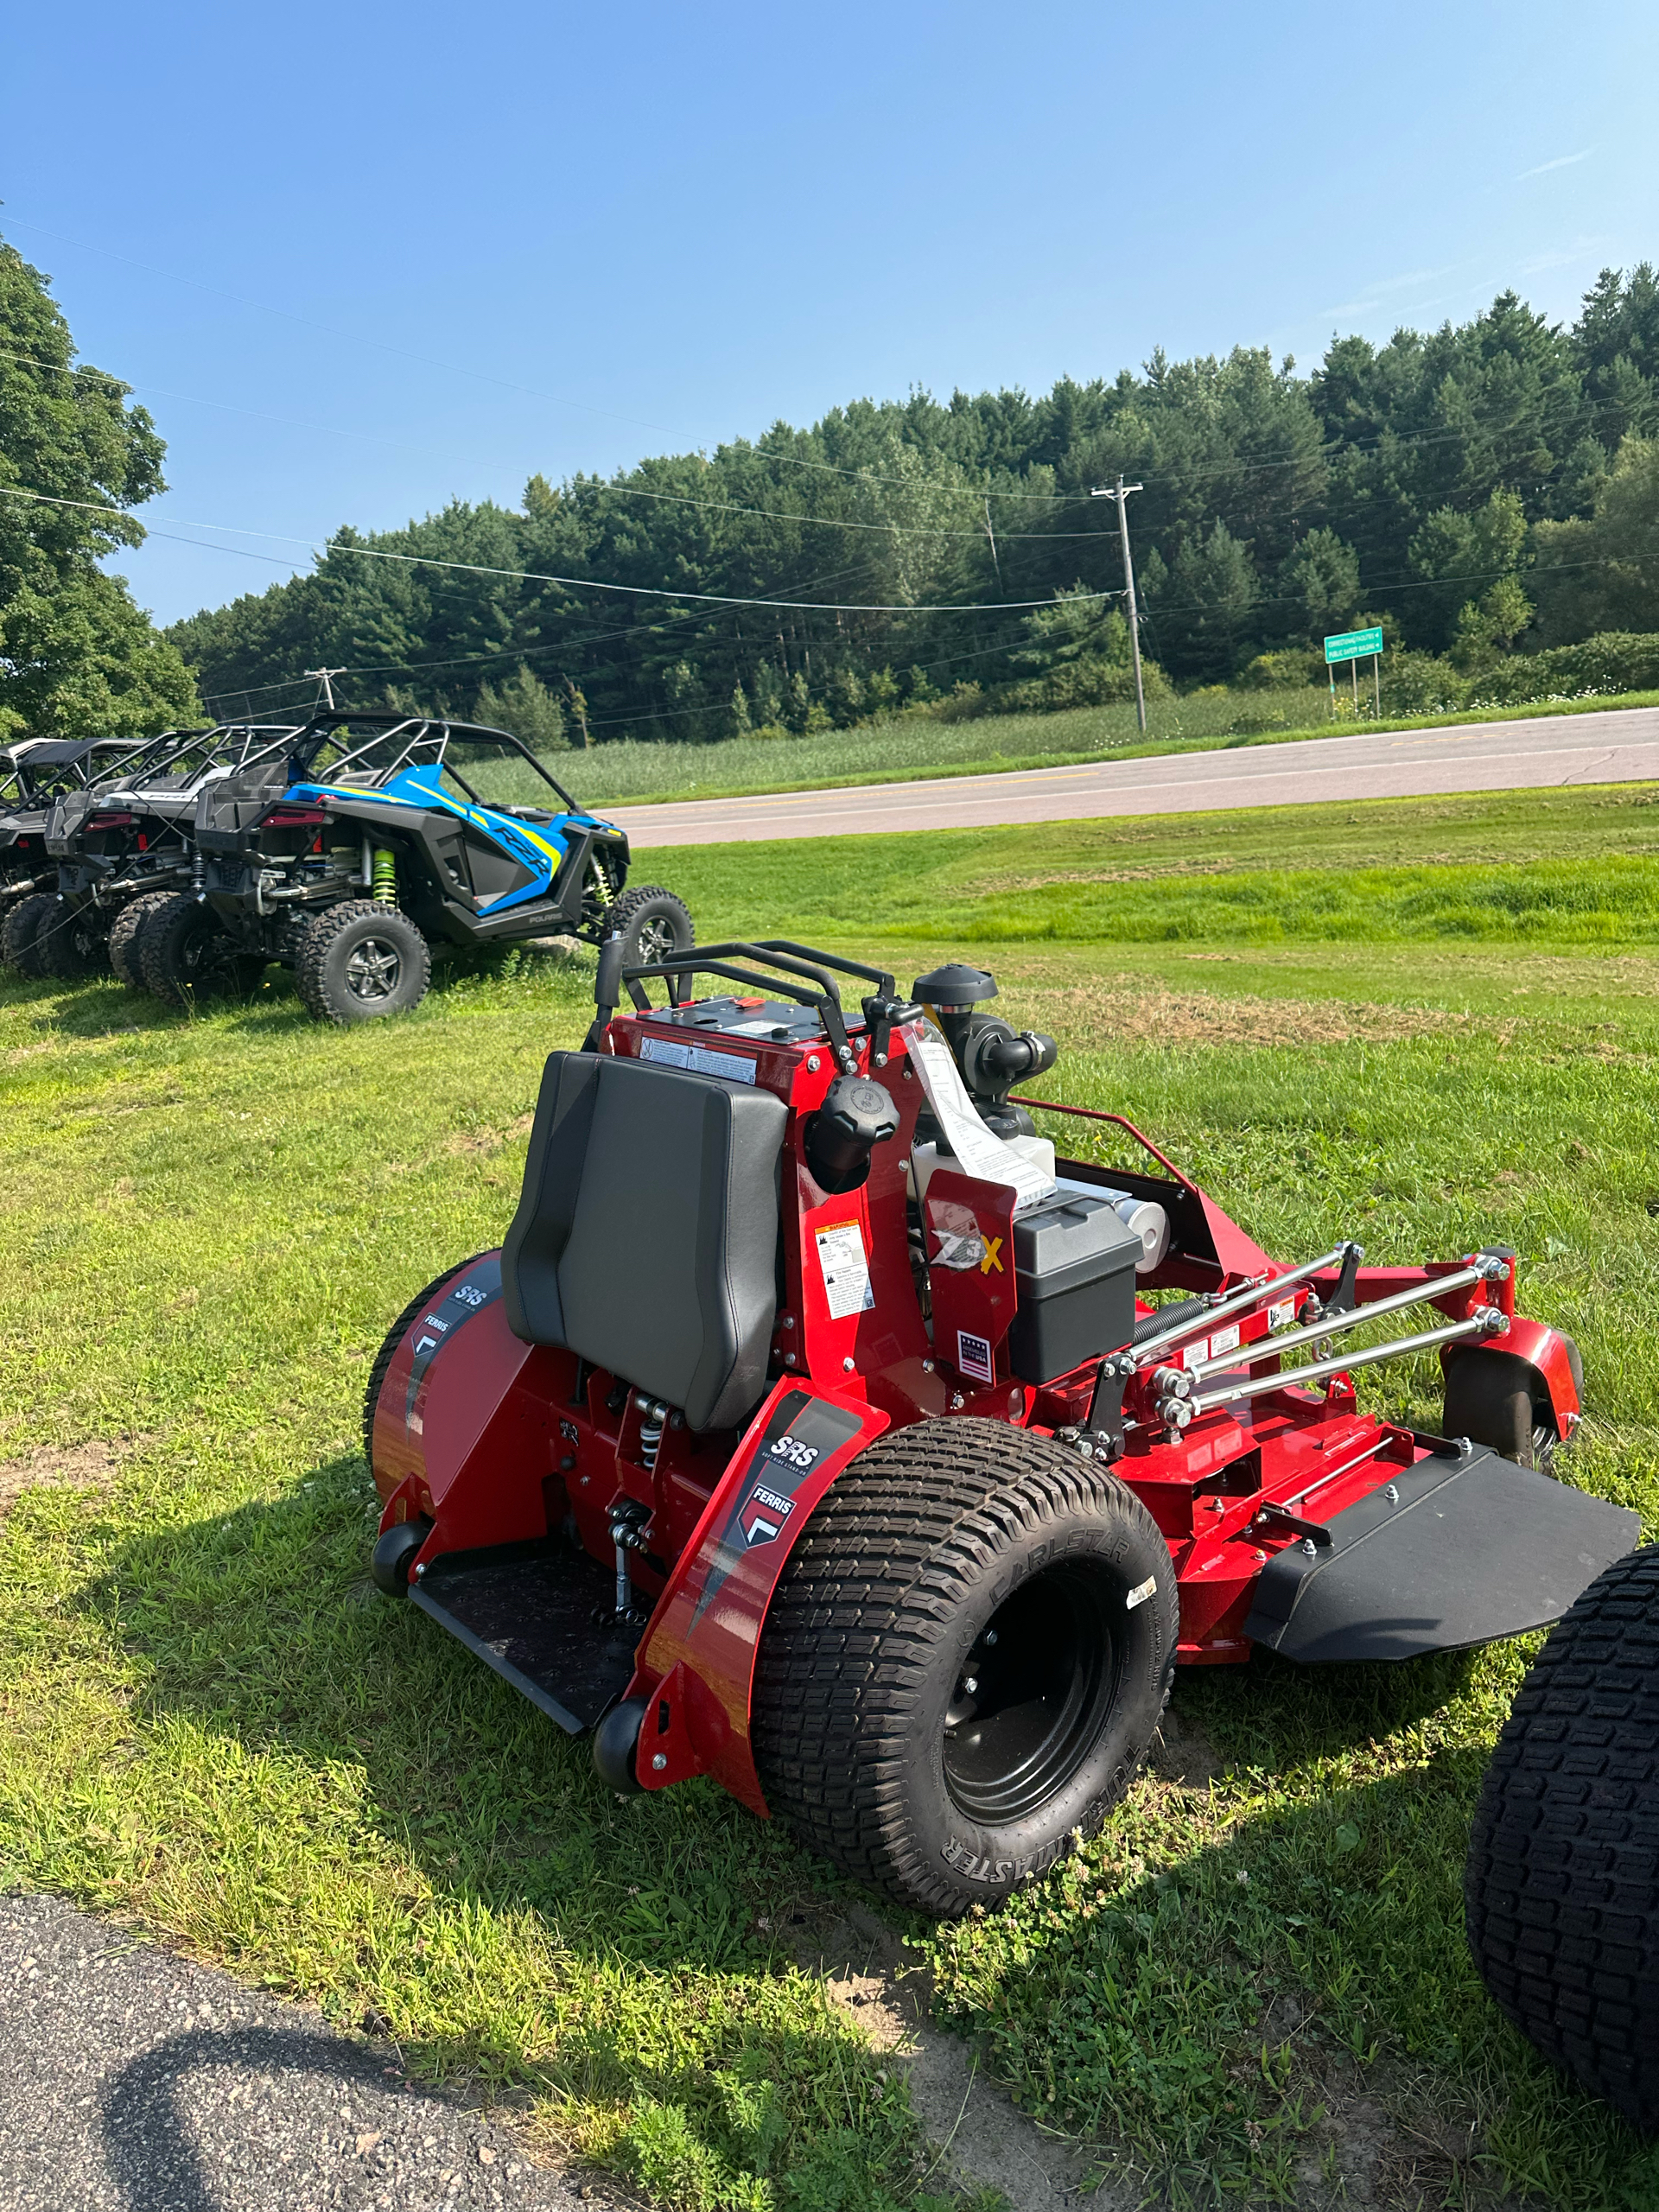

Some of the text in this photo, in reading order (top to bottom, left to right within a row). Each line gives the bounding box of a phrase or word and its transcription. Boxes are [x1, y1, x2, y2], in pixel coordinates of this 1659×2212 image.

[493, 827, 550, 877] RZR
[529, 912, 563, 924] POLARIS
[455, 1285, 487, 1306] SRS
[424, 1315, 448, 1332] FERRIS
[976, 1354, 987, 1363] USA
[771, 1436, 818, 1466] SRS
[773, 1457, 785, 1465] RIDE
[785, 1463, 807, 1476] STAND-ON
[753, 1487, 791, 1514] FERRIS
[989, 1528, 1130, 1605] CARLSTAR
[940, 1832, 1065, 1884] MASTER
